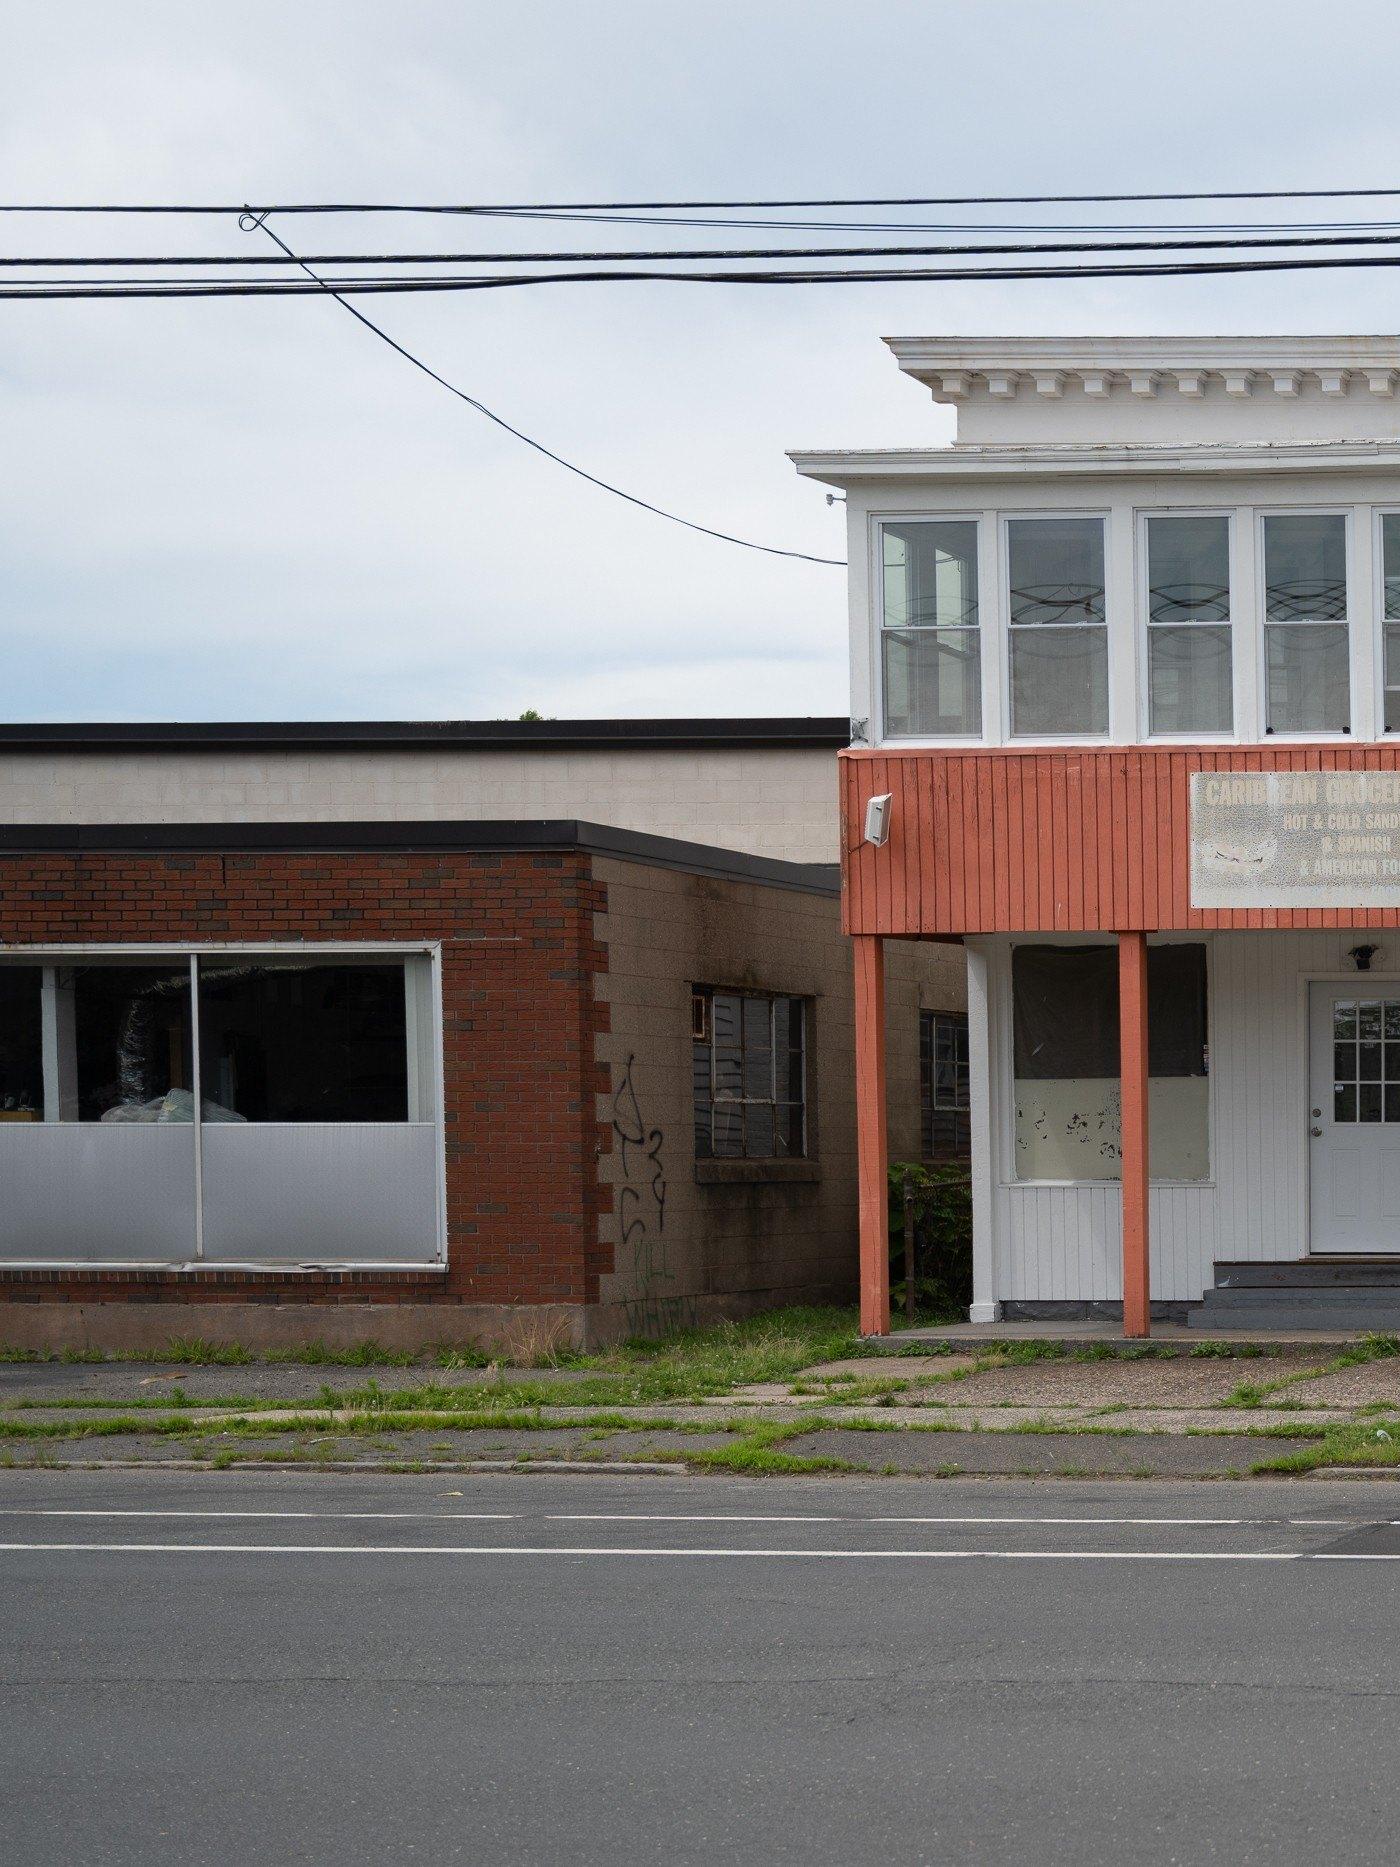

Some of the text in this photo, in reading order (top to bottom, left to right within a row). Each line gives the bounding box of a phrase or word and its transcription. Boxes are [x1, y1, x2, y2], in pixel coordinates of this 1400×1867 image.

[1205, 779, 1317, 806] CARIBEAN
[1284, 813, 1308, 830] HOT
[1313, 813, 1323, 829] &
[1327, 813, 1360, 829] COLD
[1338, 835, 1391, 852] SPANISH
[1313, 859, 1379, 875] AMERICAN
